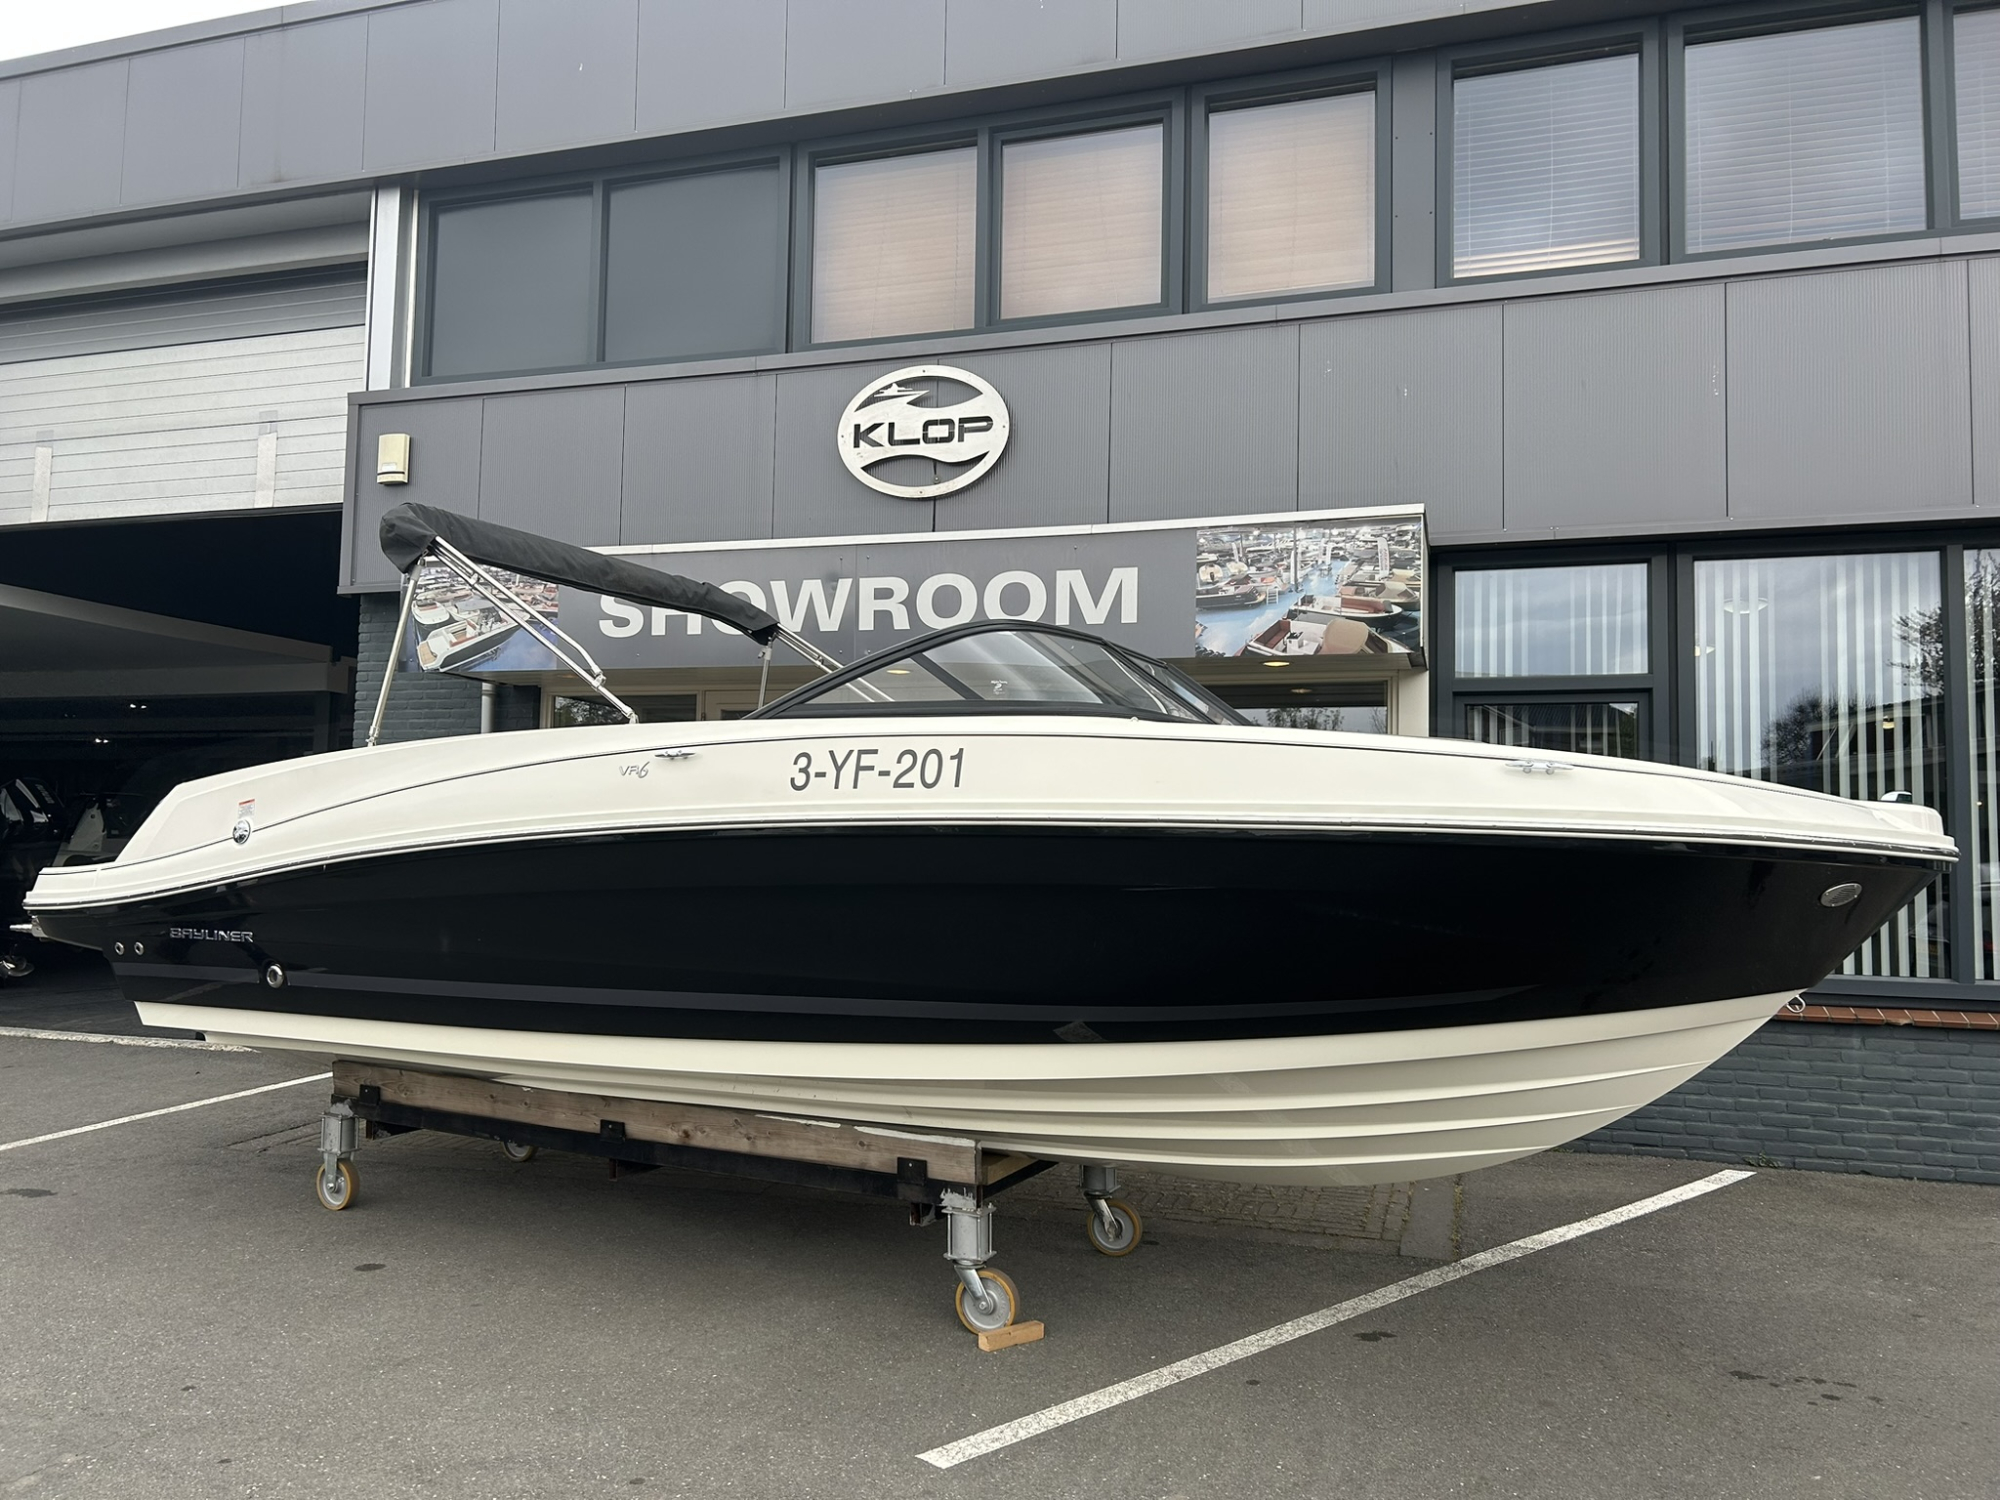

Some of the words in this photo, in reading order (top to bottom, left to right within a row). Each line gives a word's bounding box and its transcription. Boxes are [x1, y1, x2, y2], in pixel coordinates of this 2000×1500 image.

[853, 415, 994, 448] KLOP
[790, 748, 964, 791] 3-YF-201
[169, 927, 254, 942] BAYLINER
